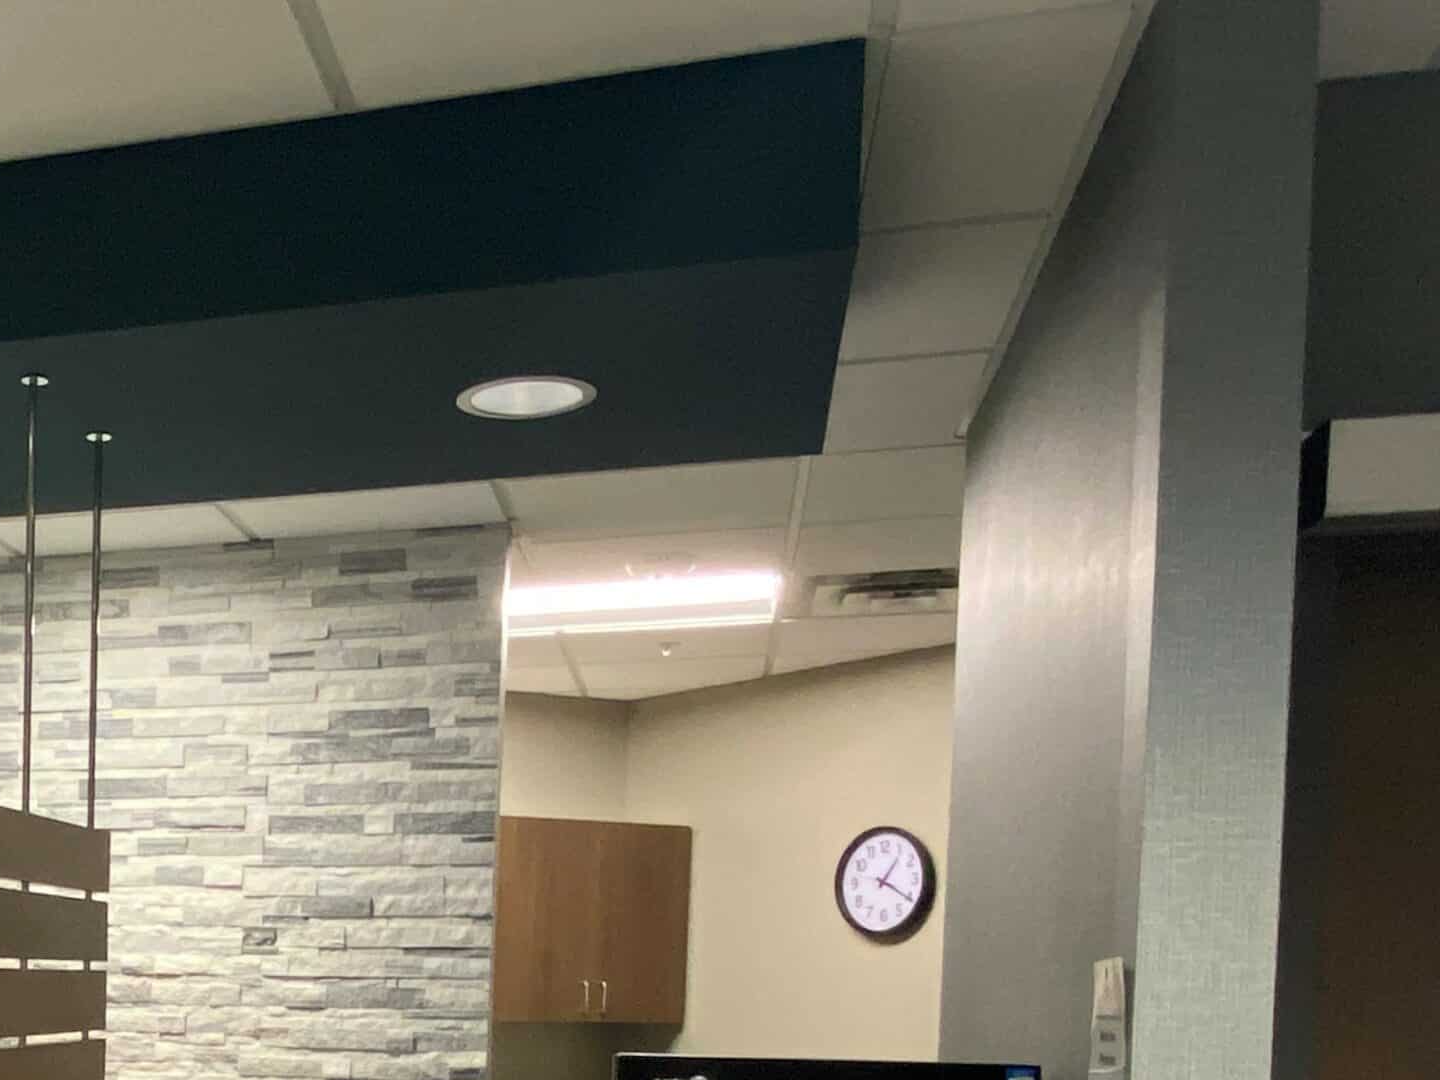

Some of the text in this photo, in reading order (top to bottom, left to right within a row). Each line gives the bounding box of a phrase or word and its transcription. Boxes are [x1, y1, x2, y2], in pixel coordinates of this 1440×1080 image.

[866, 845, 876, 859] 11
[879, 839, 890, 854] 12
[896, 843, 902, 856] 1
[856, 858, 867, 872] 10
[906, 853, 915, 868] 2
[850, 877, 858, 890] 9
[911, 871, 919, 885] 3
[855, 895, 863, 909] 8
[864, 905, 874, 919] 7
[879, 908, 888, 922] 6
[895, 903, 903, 917] 5
